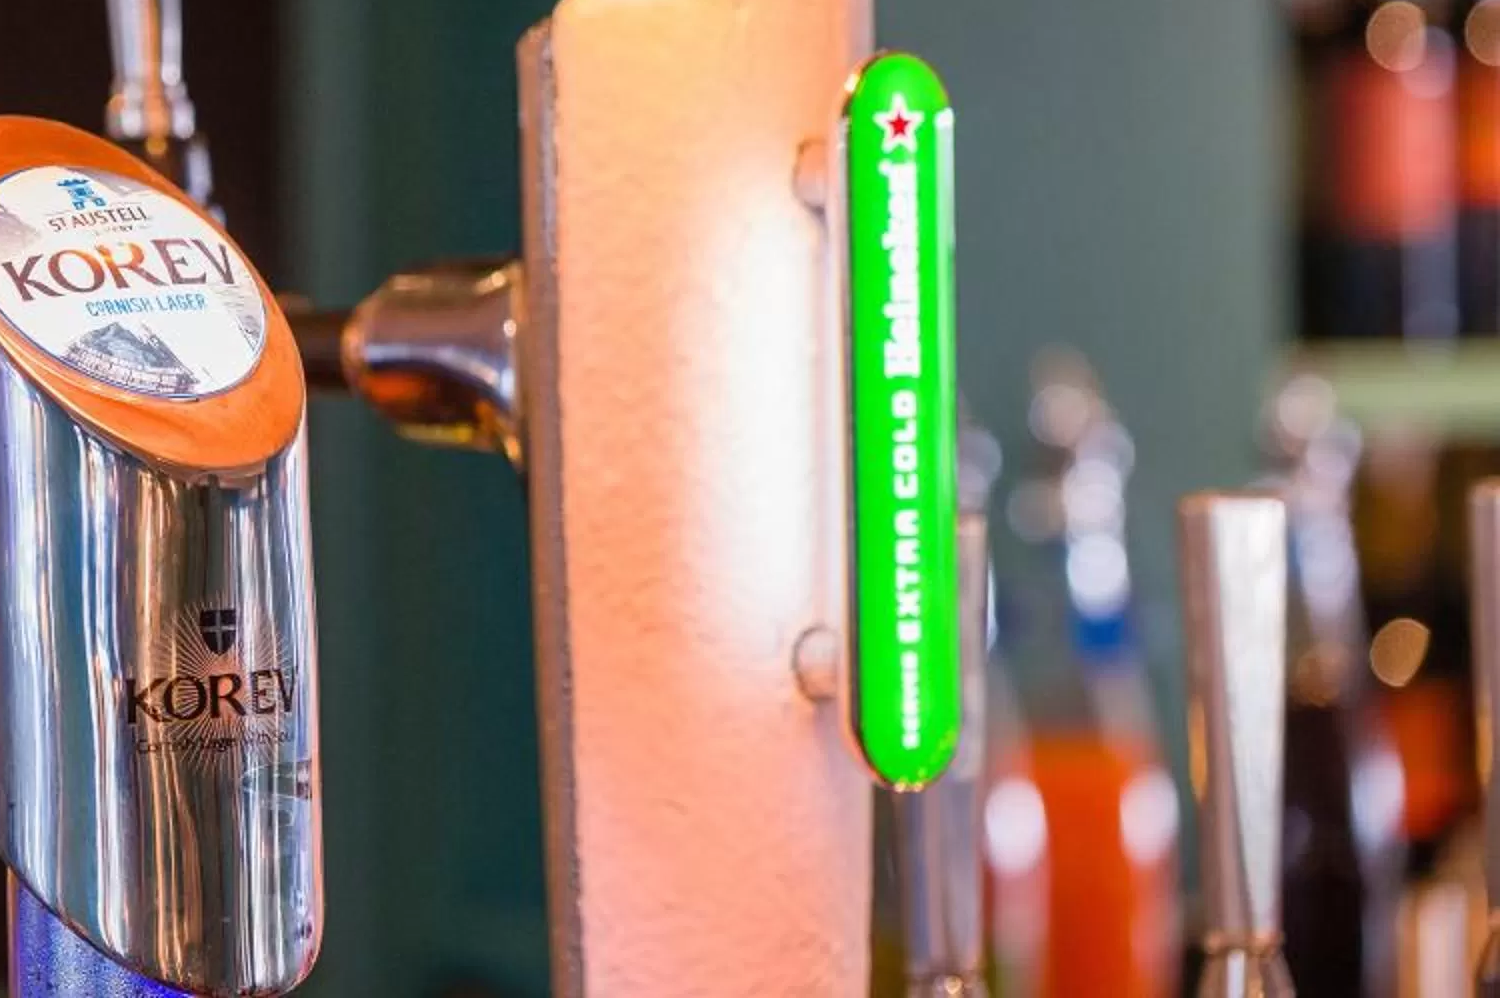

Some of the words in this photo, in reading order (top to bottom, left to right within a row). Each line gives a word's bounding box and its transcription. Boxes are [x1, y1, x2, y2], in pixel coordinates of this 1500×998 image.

[71, 205, 150, 229] AUSTELL
[1, 238, 235, 303] KOREV
[85, 296, 154, 317] CORNISH
[156, 292, 207, 312] LAGER
[891, 389, 919, 500] COLD
[895, 509, 922, 644] EXTRA
[124, 669, 297, 724] KOREV
